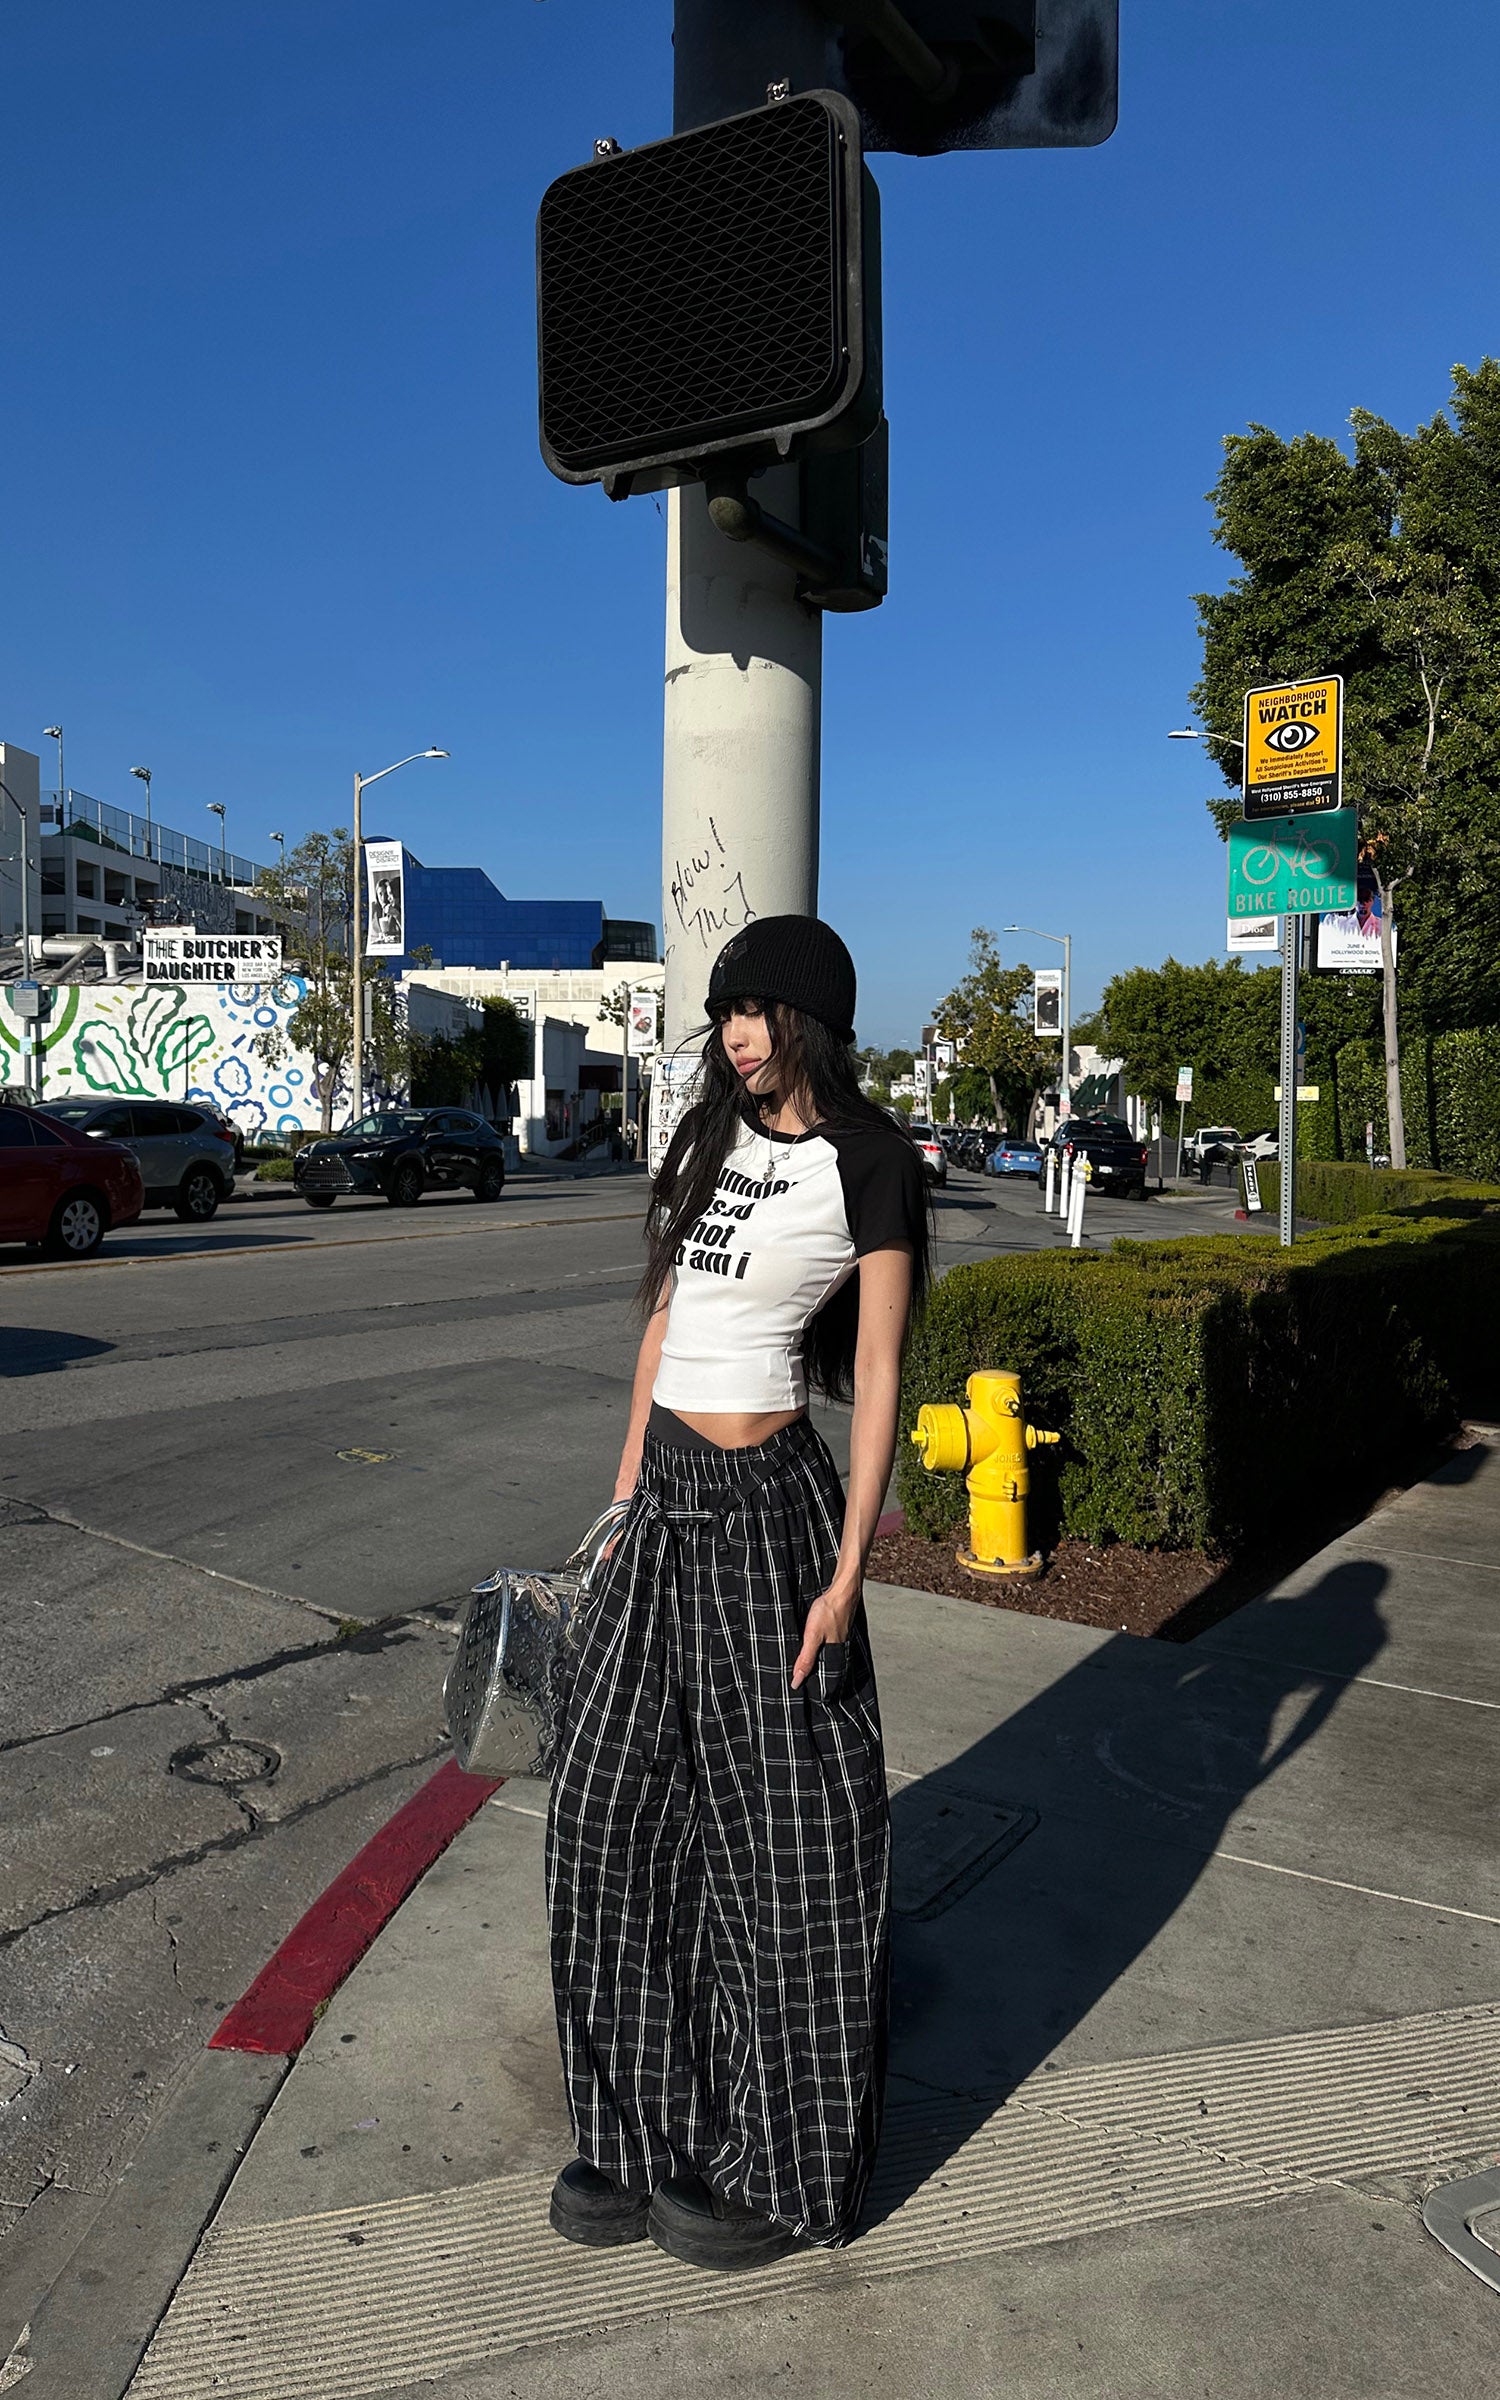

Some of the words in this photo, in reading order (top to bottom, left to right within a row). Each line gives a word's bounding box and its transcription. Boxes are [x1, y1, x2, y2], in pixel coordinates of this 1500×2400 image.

[1259, 689, 1327, 708] NEIGHBORHOOD
[1259, 699, 1326, 723] WATCH
[1270, 753, 1303, 763] Immediately
[1305, 750, 1323, 758] Report
[1264, 763, 1293, 772] Suspicious
[1295, 759, 1321, 767] Activities
[1269, 769, 1291, 778] Sheriff's
[1293, 766, 1326, 777] Department
[1261, 792, 1281, 803] (310)
[1283, 787, 1322, 800] 855-8850
[1315, 795, 1330, 805] 911
[1236, 892, 1276, 912] BIKE
[1287, 885, 1348, 909] ROUTE
[1241, 924, 1265, 934] Dior
[145, 939, 179, 959] THE
[183, 940, 279, 960] BUTCHER'S
[146, 961, 236, 980] DAUGHTER
[689, 1249, 733, 1276] am
[734, 1251, 752, 1280] i
